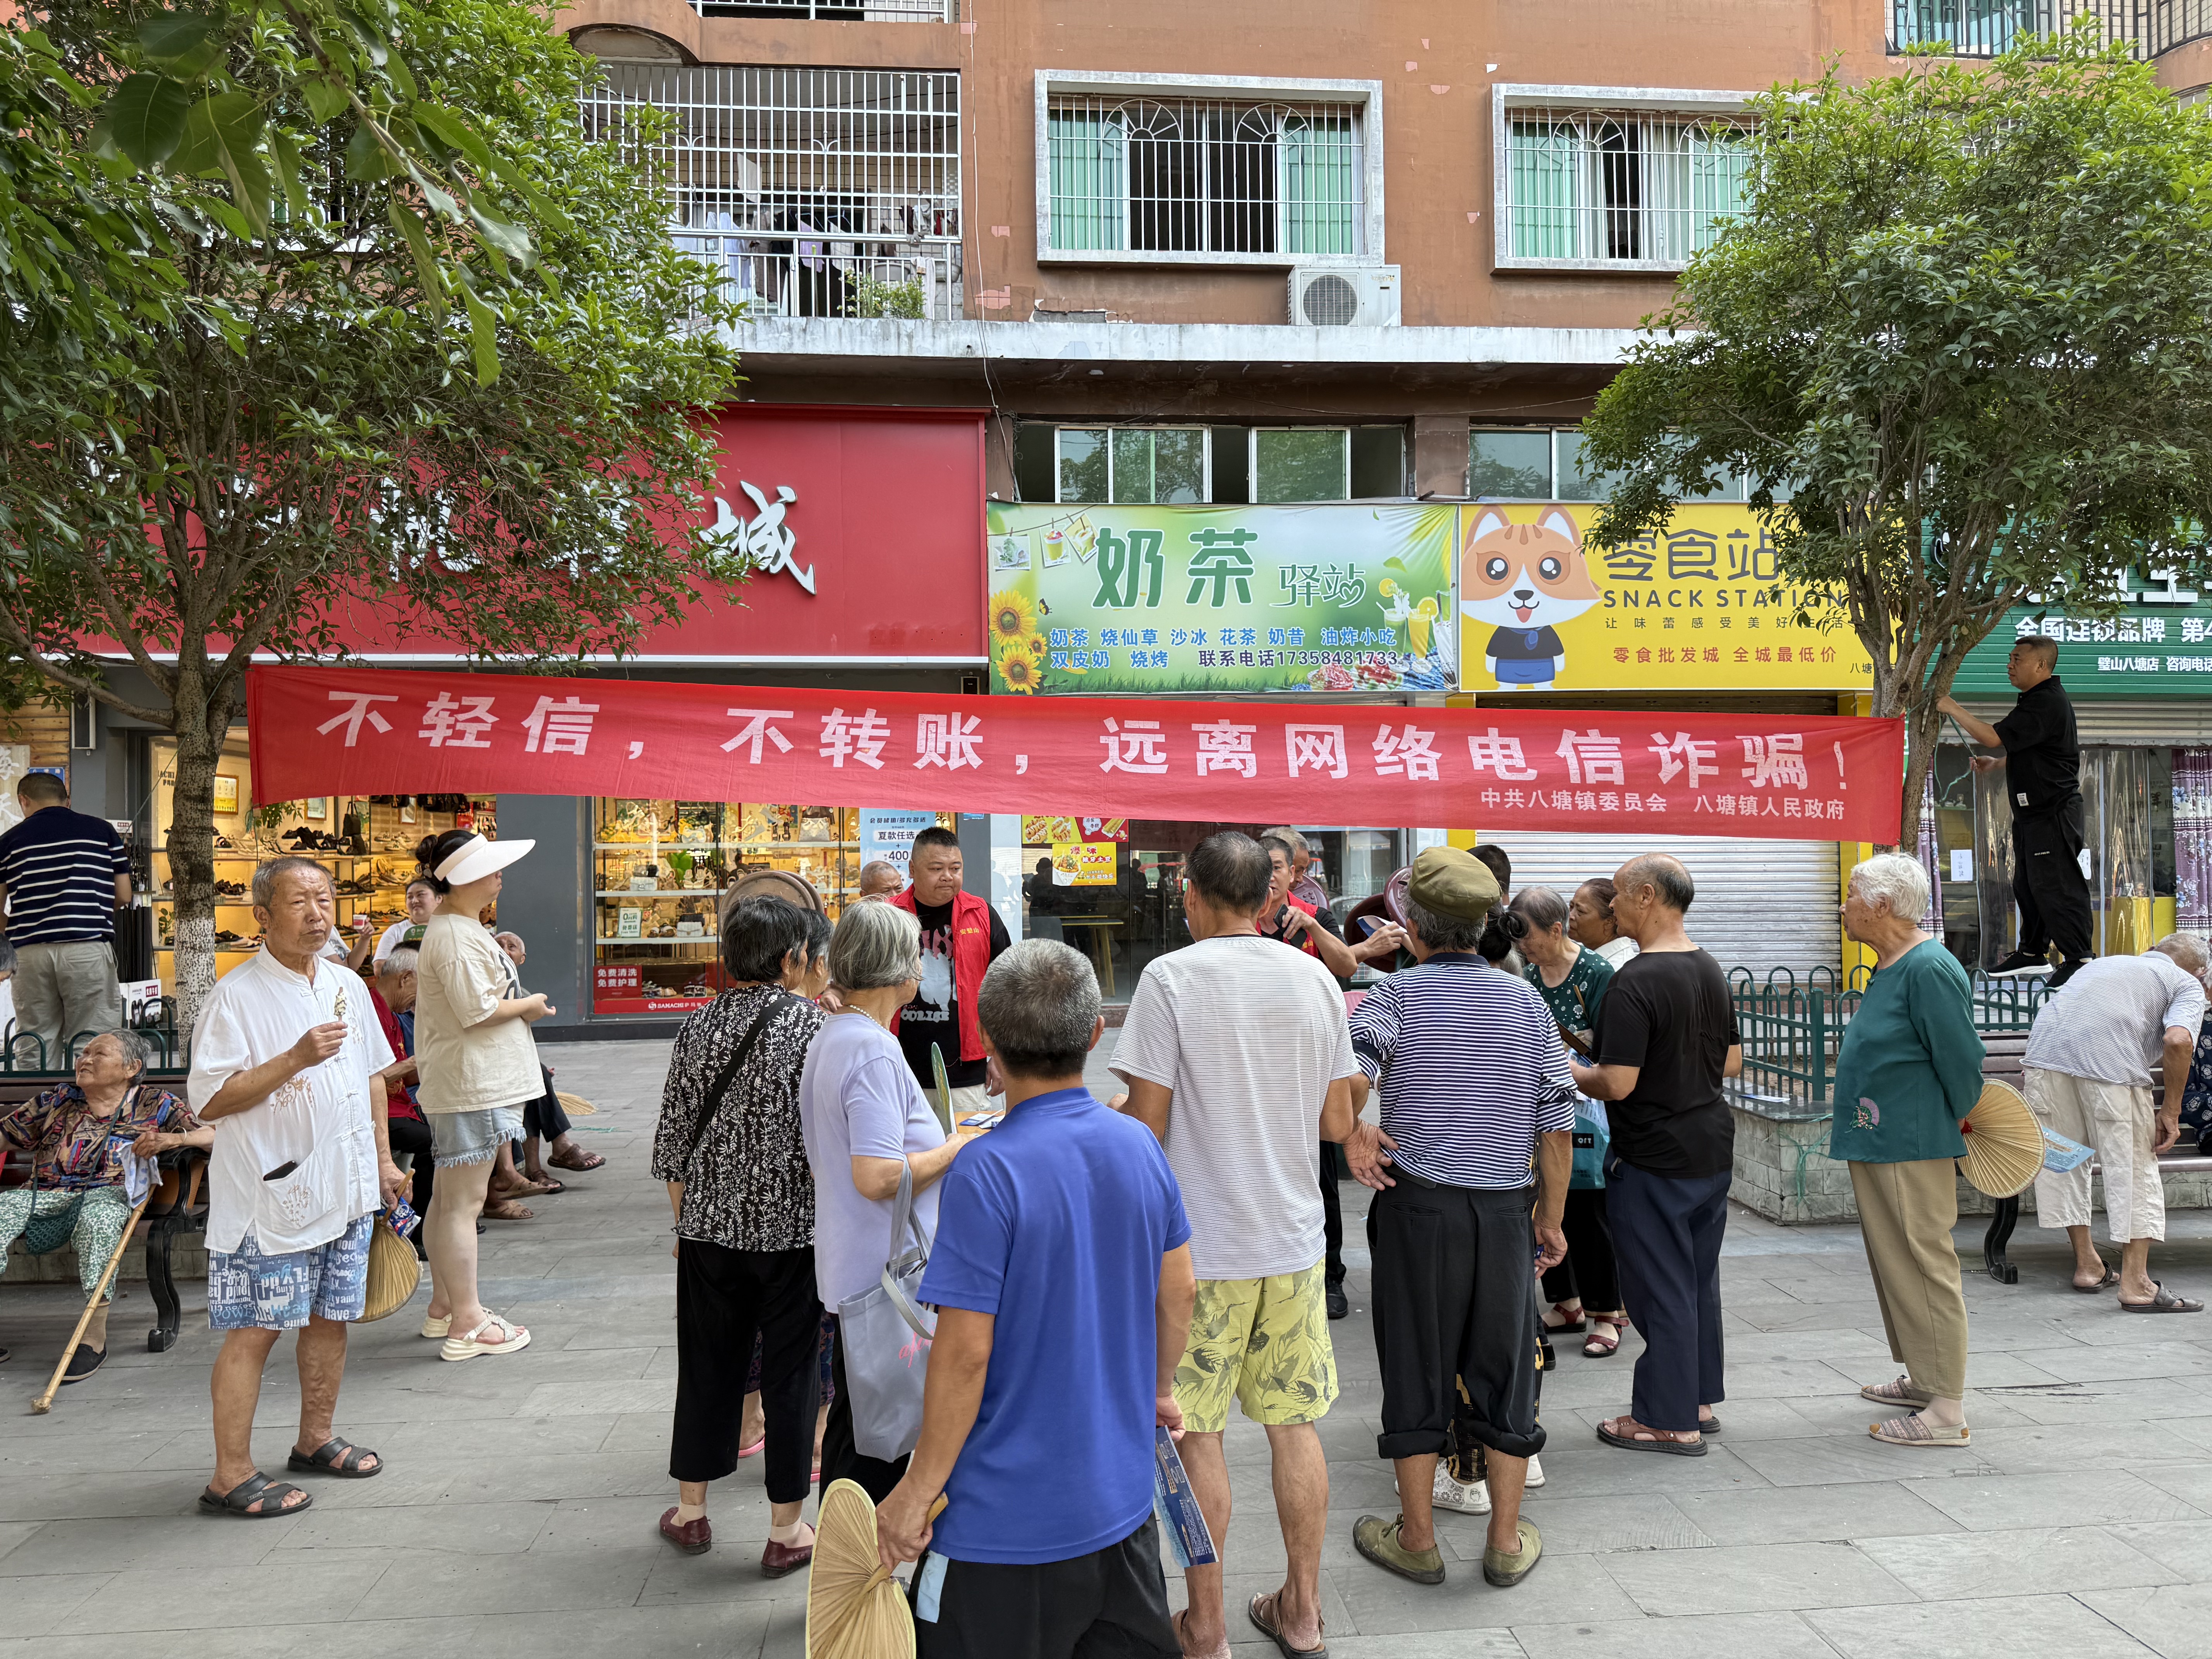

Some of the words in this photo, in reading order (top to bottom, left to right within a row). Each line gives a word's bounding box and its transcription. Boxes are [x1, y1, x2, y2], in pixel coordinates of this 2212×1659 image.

[1092, 528, 1258, 609] 奶茶
[1270, 563, 1366, 608] 驿站
[1604, 589, 1704, 608] SNACK
[1716, 589, 1843, 608] STATION
[1050, 628, 1089, 647] 奶茶
[1101, 628, 1159, 647] 烧仙草
[1170, 627, 1207, 646] 沙冰
[1219, 627, 1257, 646] 花茶
[1268, 627, 1306, 646] 奶昔
[1321, 627, 1397, 646] 油炸小吃
[2015, 617, 2166, 643] 全国连锁品牌
[1051, 650, 1110, 669] 双皮奶
[1130, 650, 1169, 669] 烧烤
[1613, 646, 1719, 664] 零食批发城
[1733, 646, 1837, 663] 全城最低价
[2166, 656, 2212, 672] 咨询电话
[1480, 787, 1667, 813] 中共八塘镇委员会
[1693, 794, 1844, 820] 八塘镇人民政府
[878, 831, 915, 840] 夏款任选
[888, 851, 908, 860] 400
[598, 968, 637, 977] 免费清洗
[598, 978, 637, 987] 免费护理
